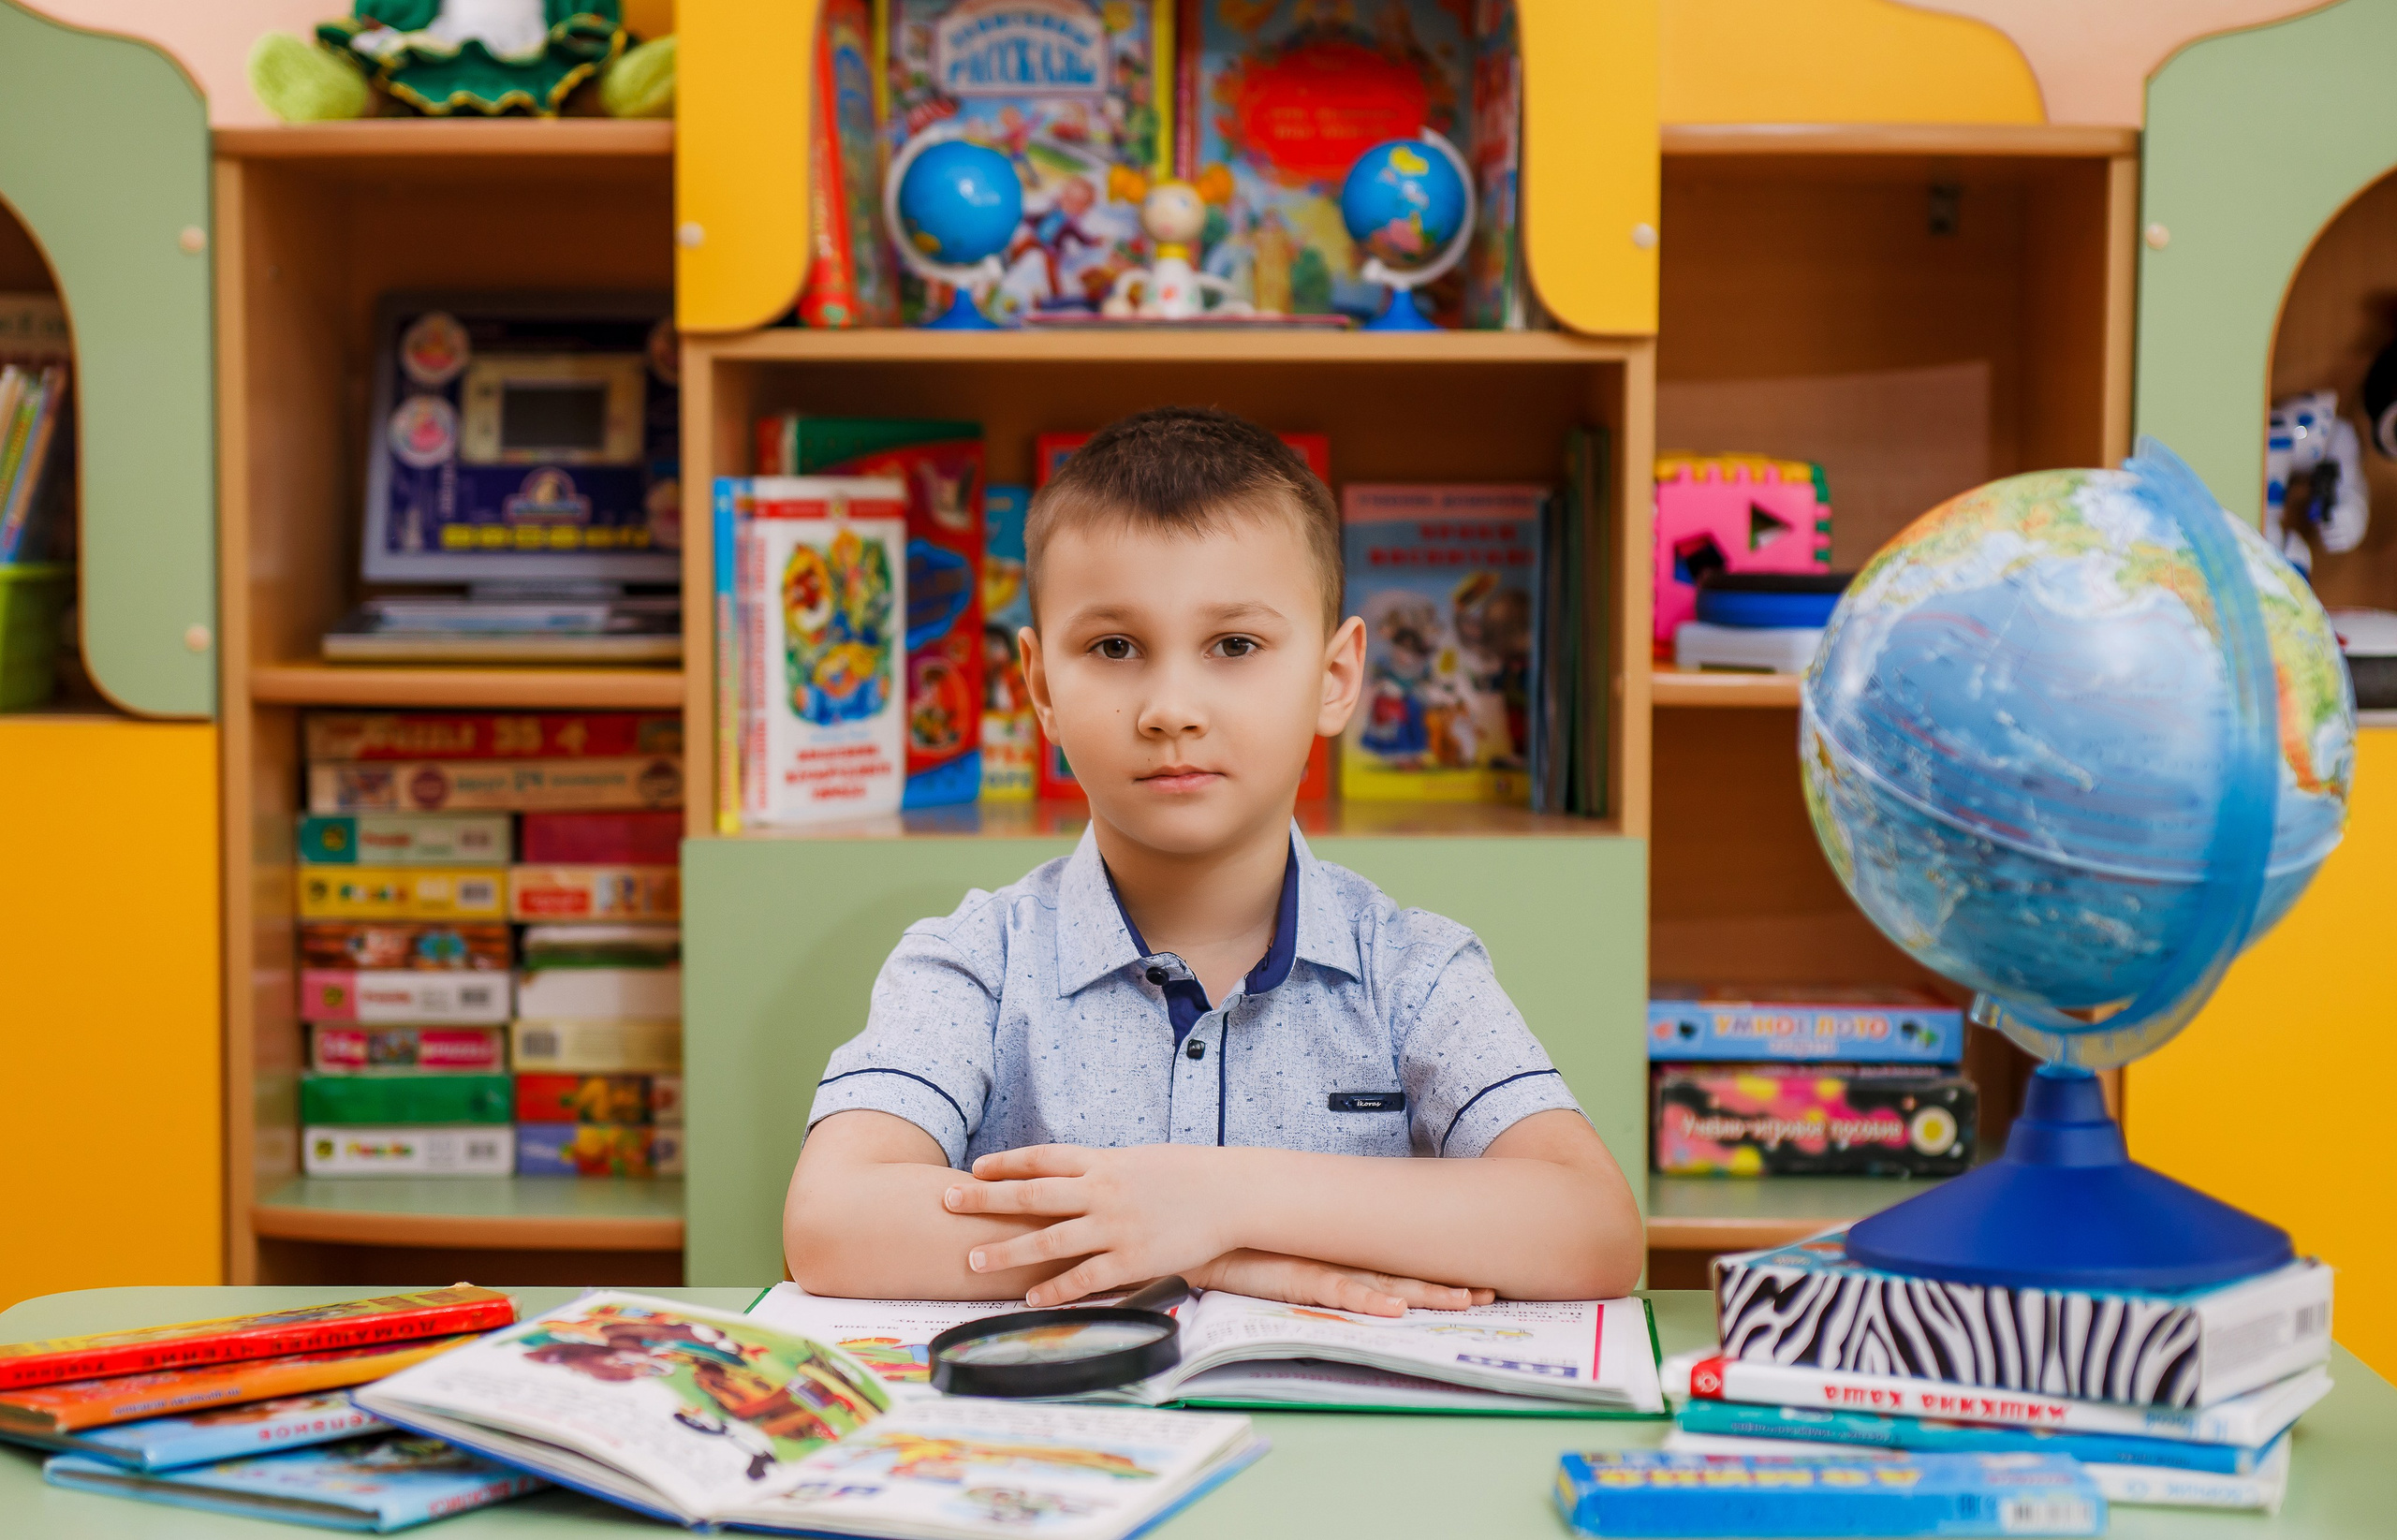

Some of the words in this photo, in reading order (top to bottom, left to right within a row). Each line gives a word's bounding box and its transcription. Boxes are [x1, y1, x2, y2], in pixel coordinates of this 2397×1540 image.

[1815, 1015, 1890, 1037] ЛОТО
[271, 1319, 438, 1354] ДОМАШНЕЕ
[142, 1345, 256, 1369] ЧТЕНИЕ
[12, 1360, 106, 1381] Учебник
